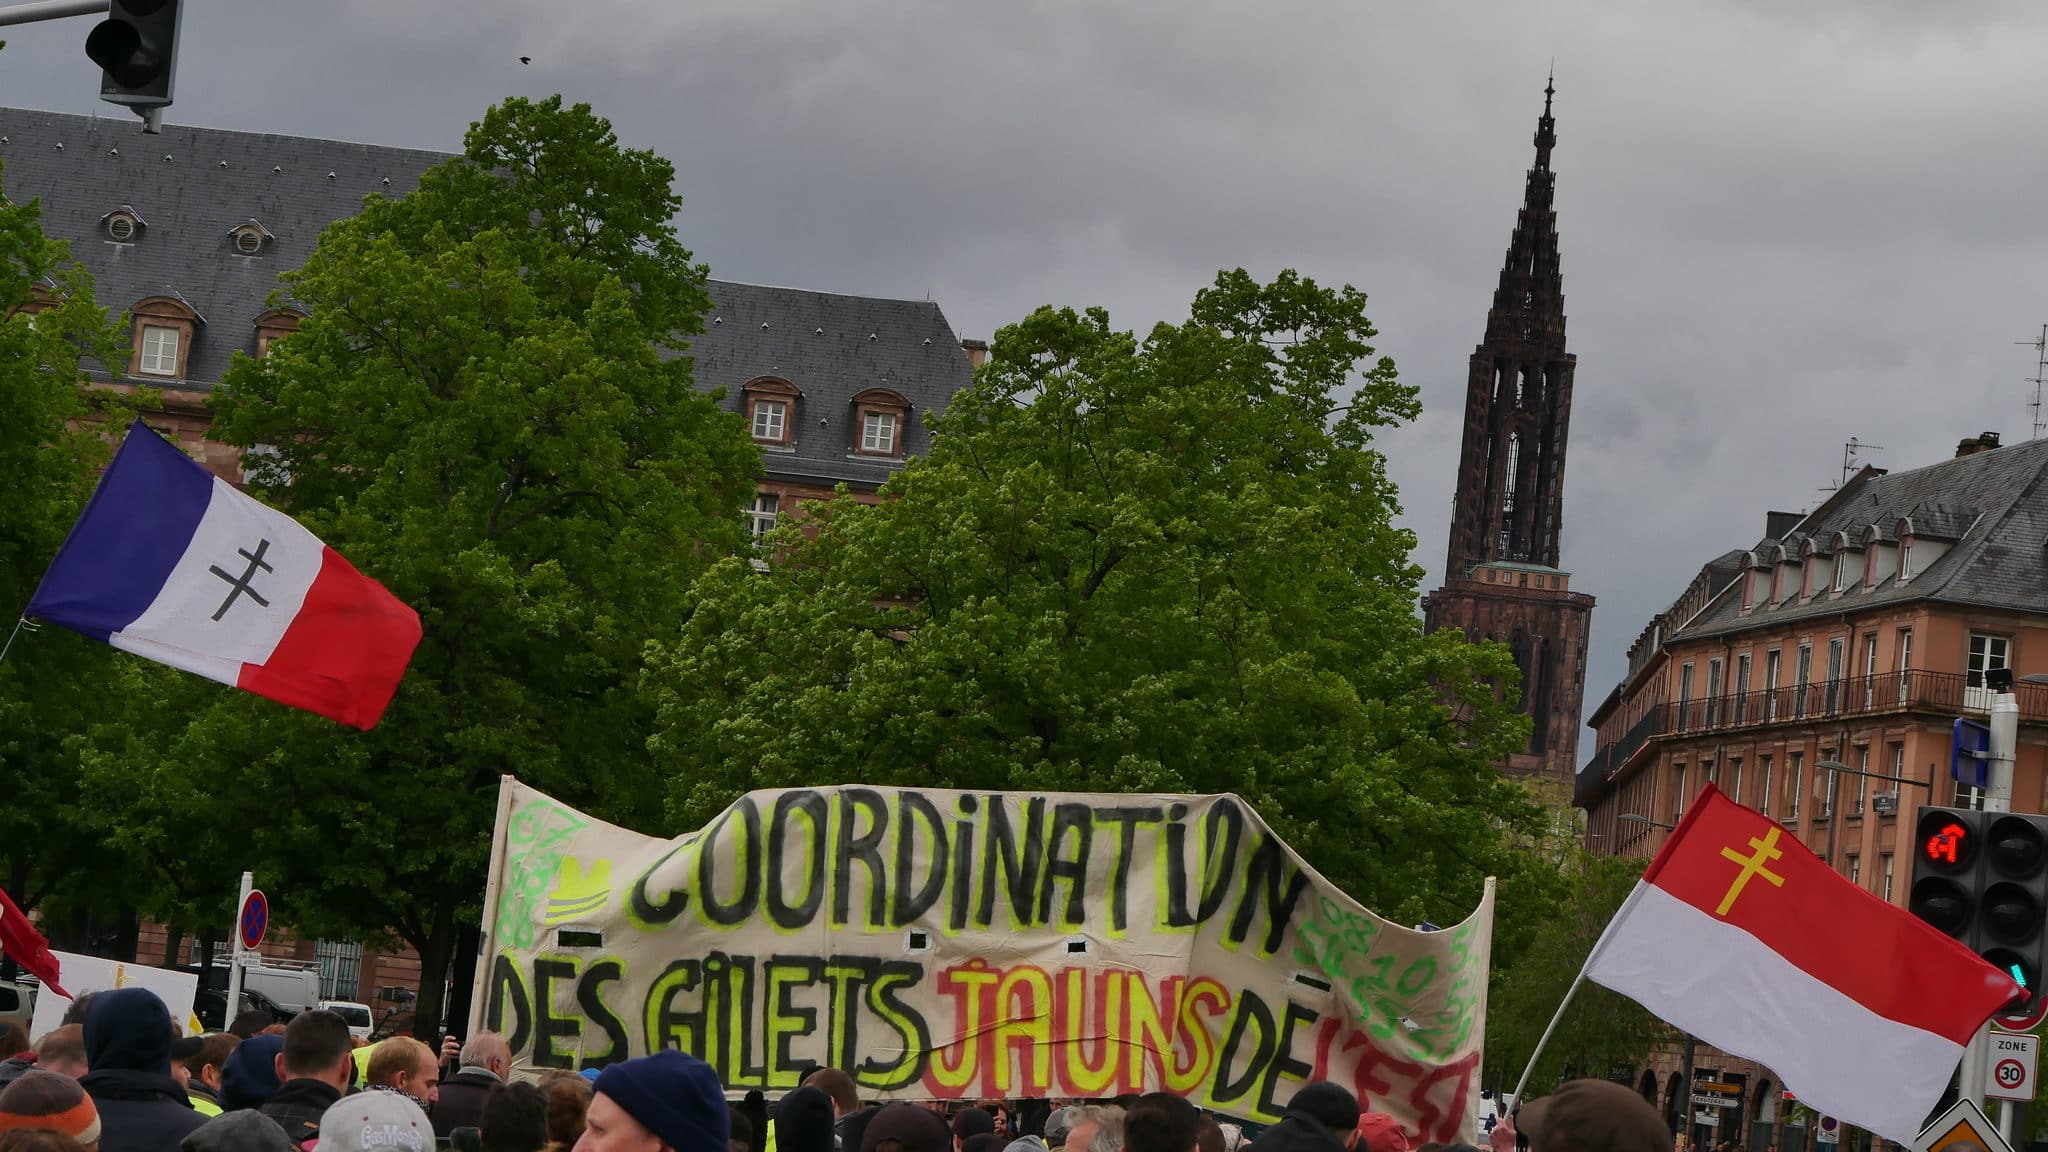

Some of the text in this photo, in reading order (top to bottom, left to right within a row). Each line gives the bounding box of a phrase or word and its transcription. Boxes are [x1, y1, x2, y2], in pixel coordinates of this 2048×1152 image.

[1370, 953, 1438, 998] 10
[487, 950, 629, 1070] DES
[1201, 986, 1321, 1126] DE
[1998, 1040, 2028, 1052] ZONE
[2000, 1066, 2020, 1081] 30
